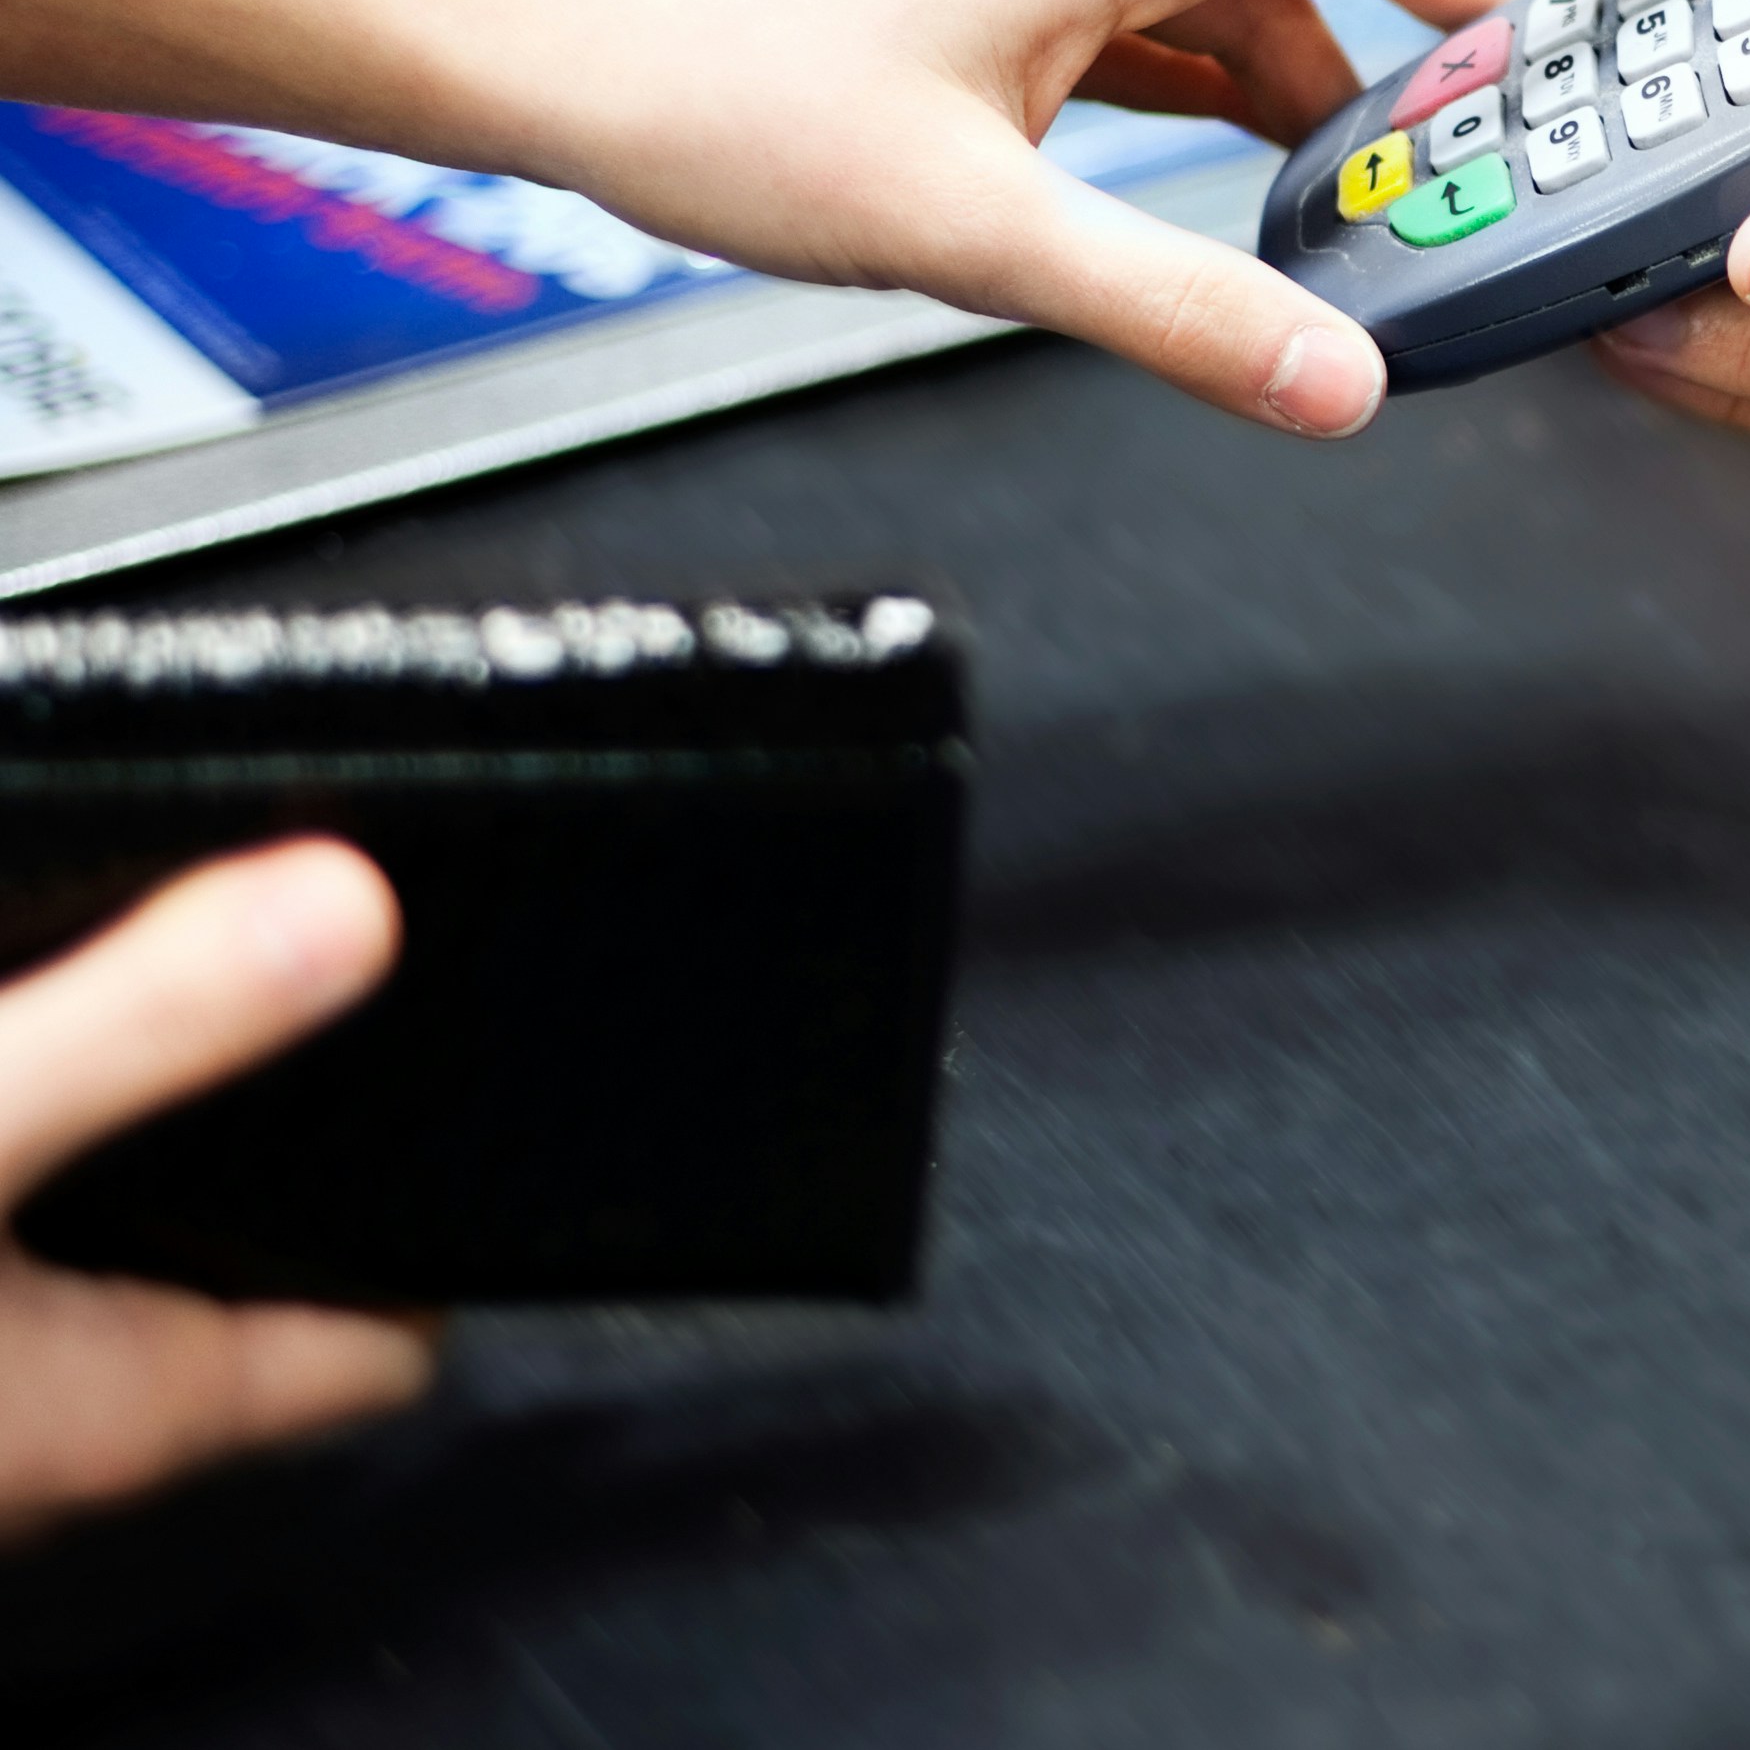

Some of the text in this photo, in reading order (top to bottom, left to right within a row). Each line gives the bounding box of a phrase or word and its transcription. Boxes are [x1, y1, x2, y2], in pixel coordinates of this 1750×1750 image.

[1636, 10, 1666, 35] 5
[1544, 54, 1574, 80] 8
[1641, 75, 1673, 122] 6 MNO
[1452, 116, 1481, 138] 0
[1549, 121, 1579, 144] 9
